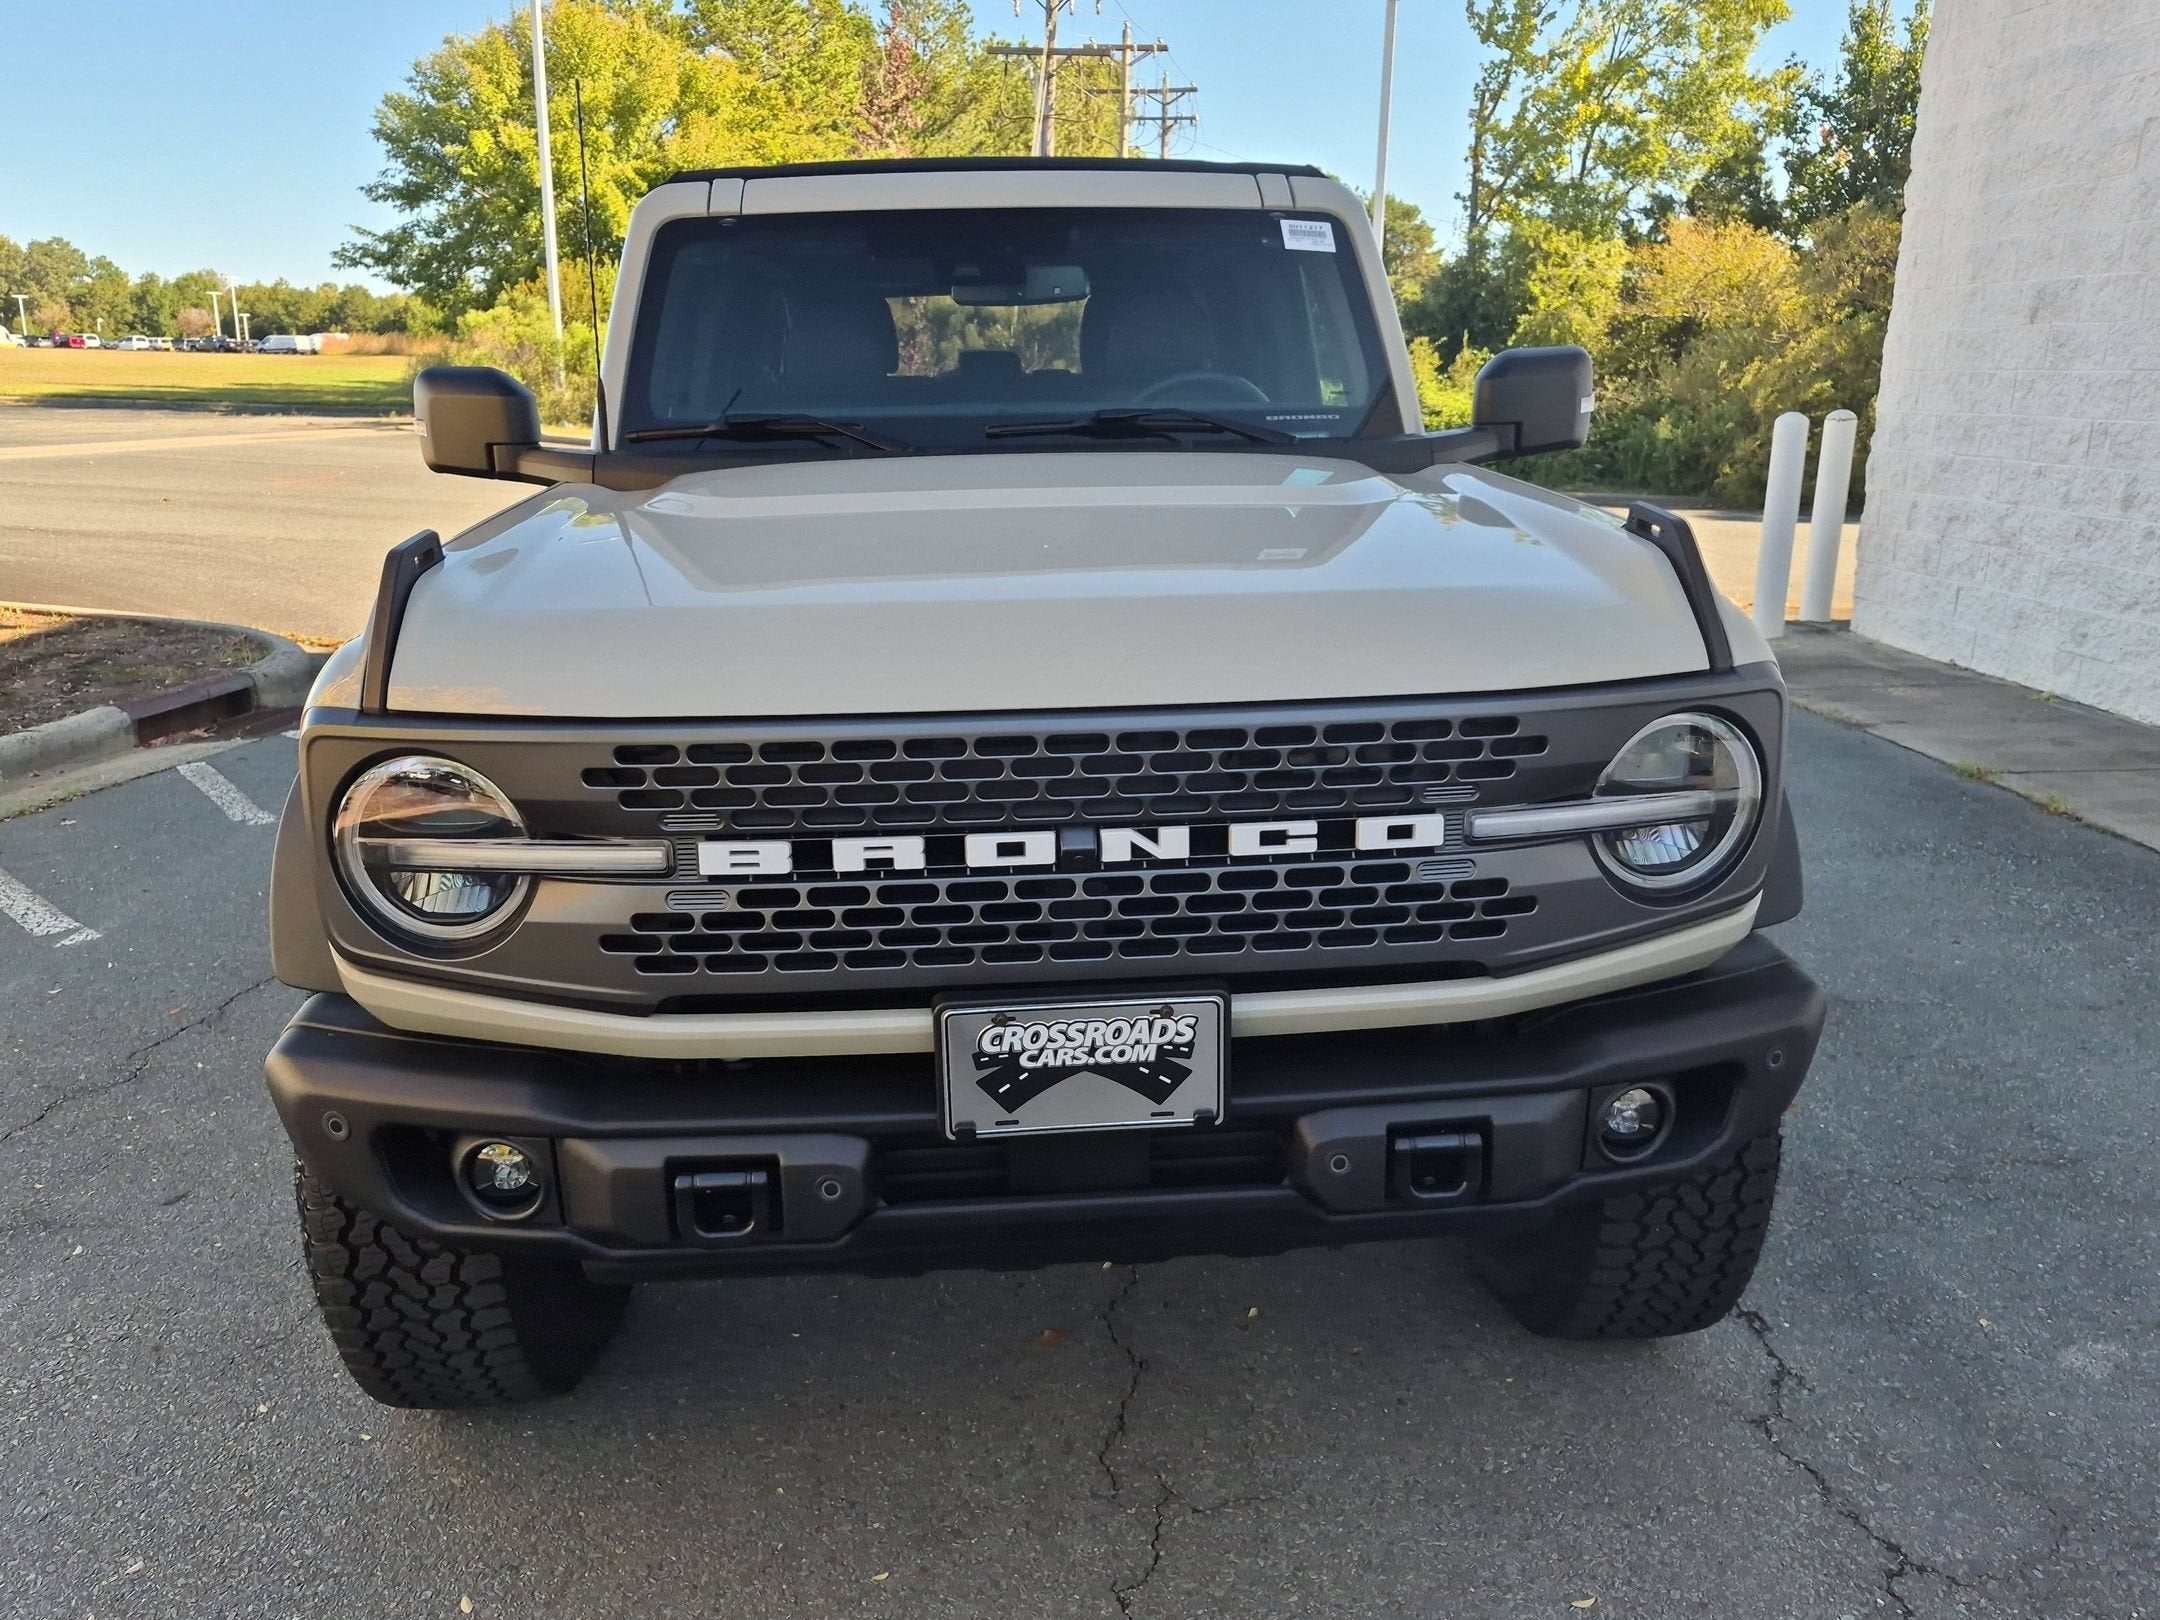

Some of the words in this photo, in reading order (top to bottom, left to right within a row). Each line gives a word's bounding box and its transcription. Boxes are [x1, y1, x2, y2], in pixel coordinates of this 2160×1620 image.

[698, 815, 1446, 877] BRONCO
[980, 1017, 1198, 1054] CROSSROADS
[1018, 1043, 1157, 1067] CARS.COM
